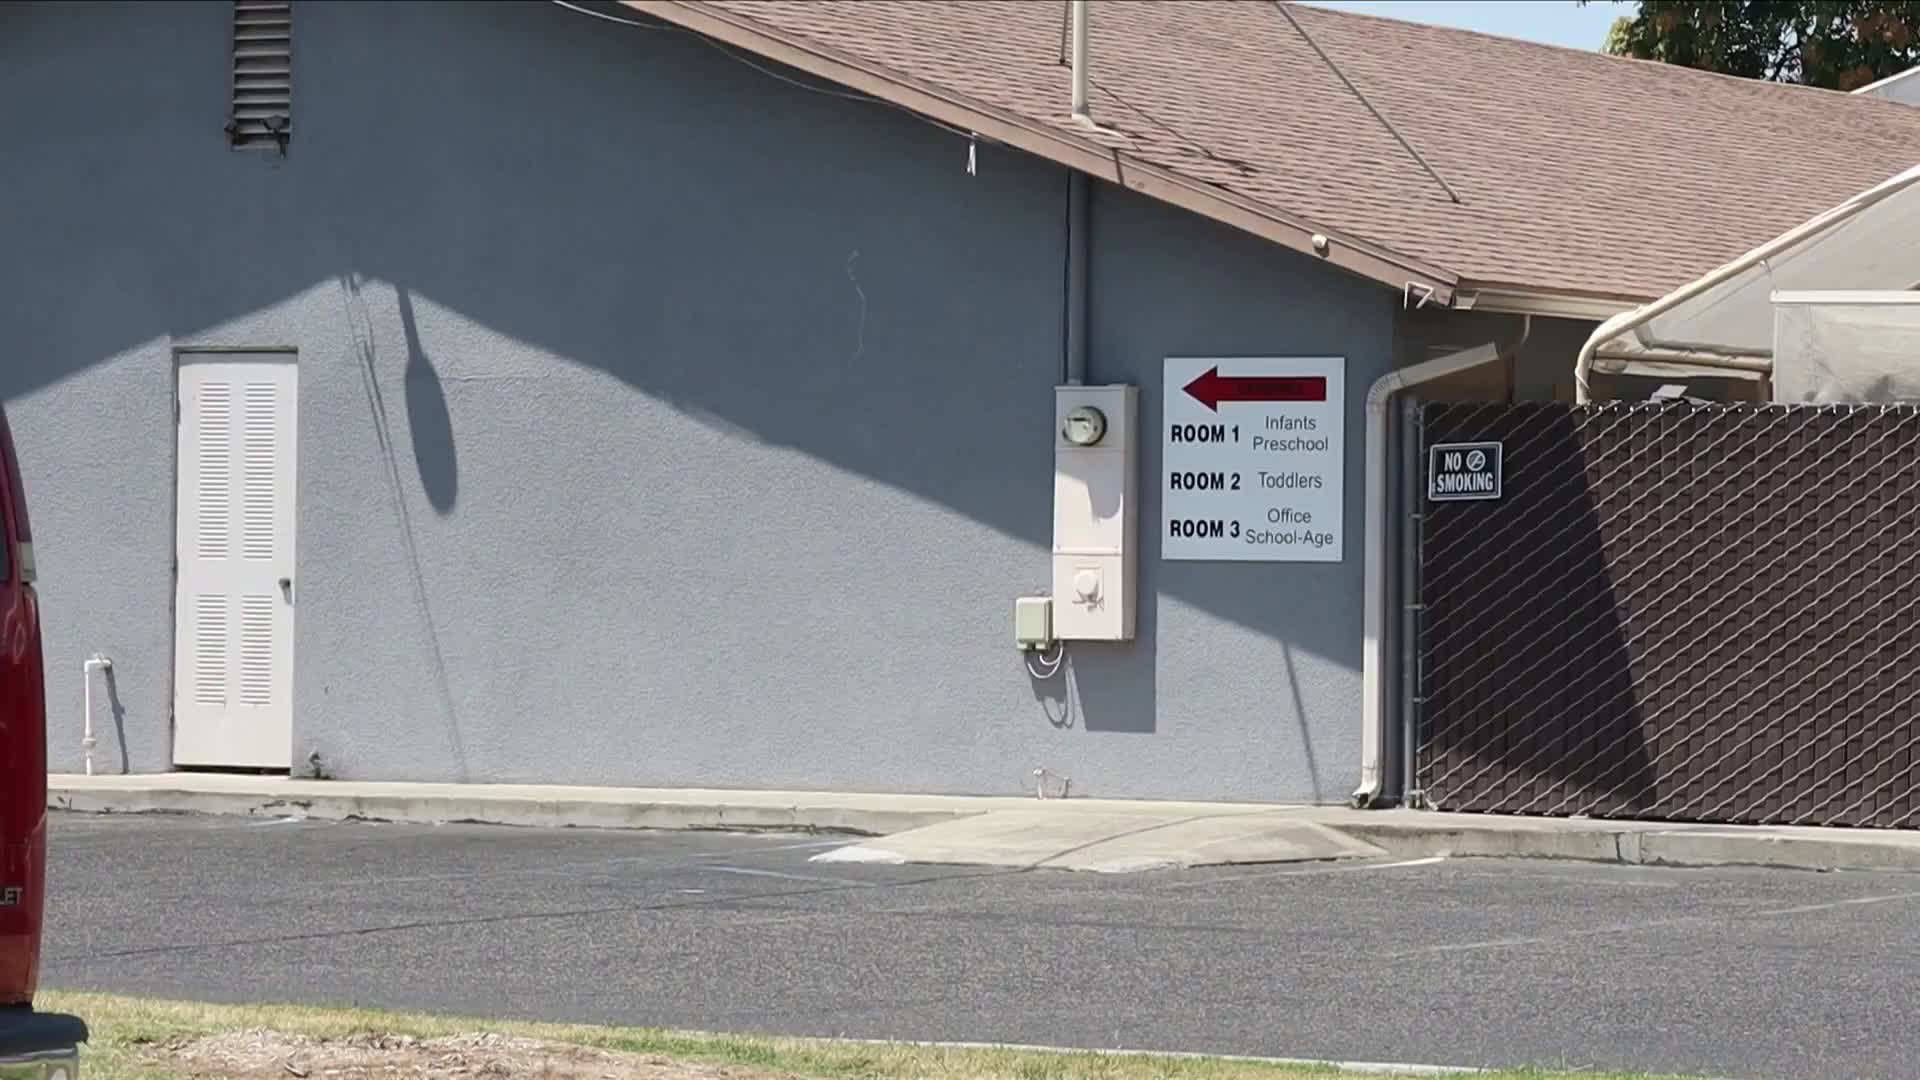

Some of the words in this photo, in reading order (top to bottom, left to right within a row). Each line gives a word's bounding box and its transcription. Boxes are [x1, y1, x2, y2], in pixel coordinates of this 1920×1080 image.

[1265, 415, 1317, 430] Infants
[1171, 424, 1225, 442] ROOM
[1232, 424, 1240, 442] 1
[1253, 436, 1329, 452] Preschool
[1444, 452, 1462, 471] NO
[1170, 472, 1224, 490] ROOM
[1231, 472, 1241, 490] 2
[1258, 471, 1322, 488] Toddlers
[1437, 472, 1494, 492] SMOKING
[1267, 508, 1312, 523] Office
[1170, 520, 1223, 538] ROOM
[1230, 520, 1240, 538] 3
[1245, 529, 1334, 548] School-Age
